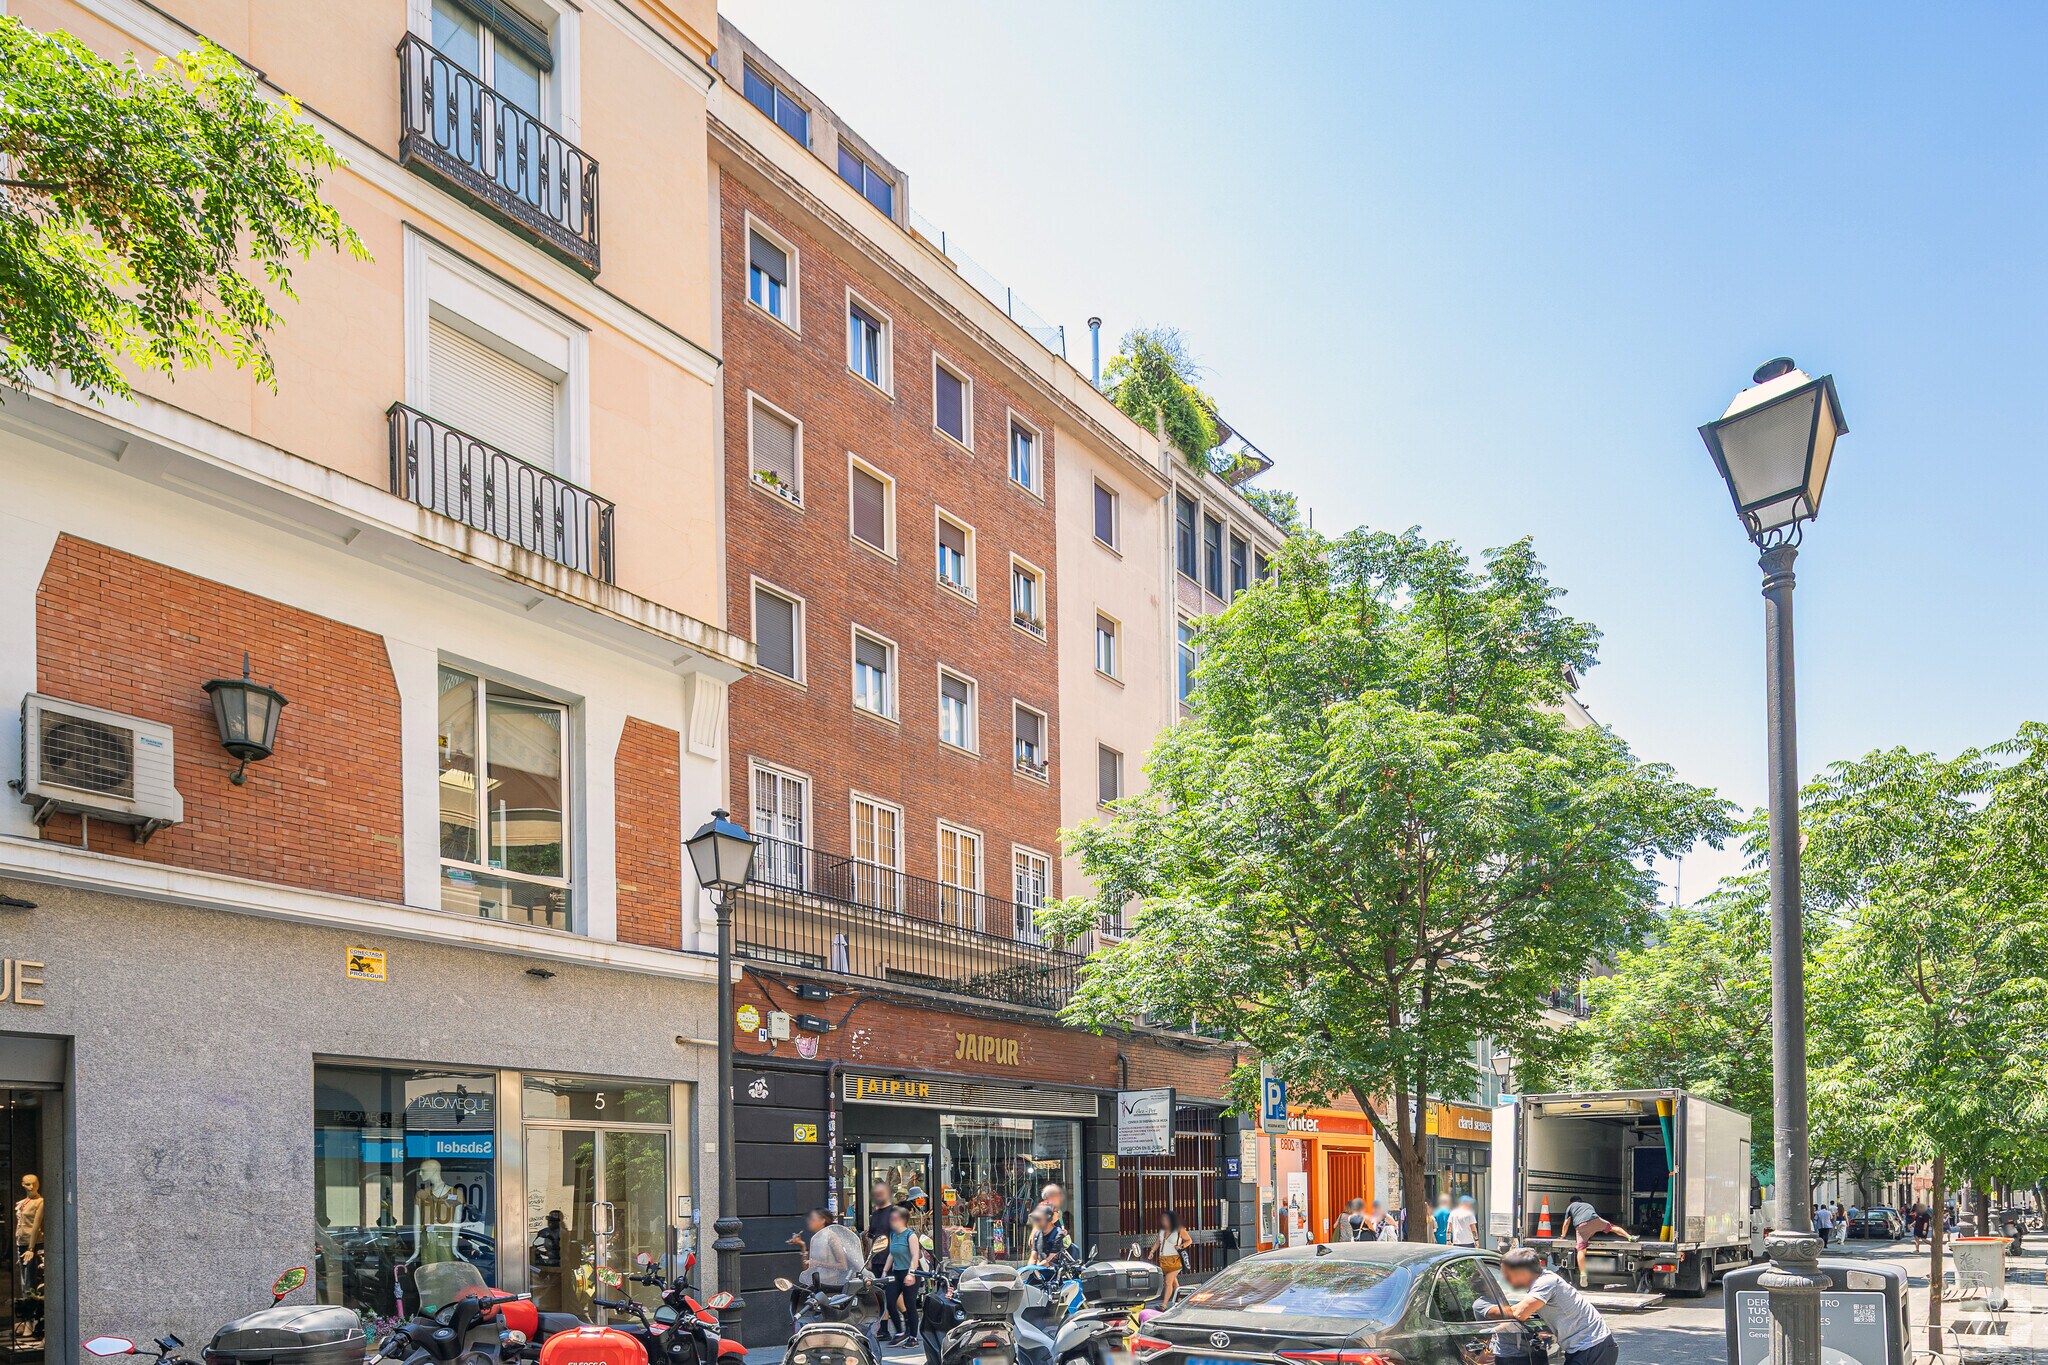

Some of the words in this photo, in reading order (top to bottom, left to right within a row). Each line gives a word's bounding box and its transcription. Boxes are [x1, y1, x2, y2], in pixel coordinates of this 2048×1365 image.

[350, 949, 383, 958] CONECTADA
[350, 971, 384, 979] PROSEGUR
[955, 1031, 1019, 1066] JAIPUR
[856, 1077, 929, 1099] JAIPUR
[418, 1096, 489, 1112] PALOMEQUE
[594, 1092, 606, 1110] 5
[1267, 1082, 1281, 1116] P
[1748, 1307, 1767, 1315] TUS
[1748, 1316, 1764, 1324] NO
